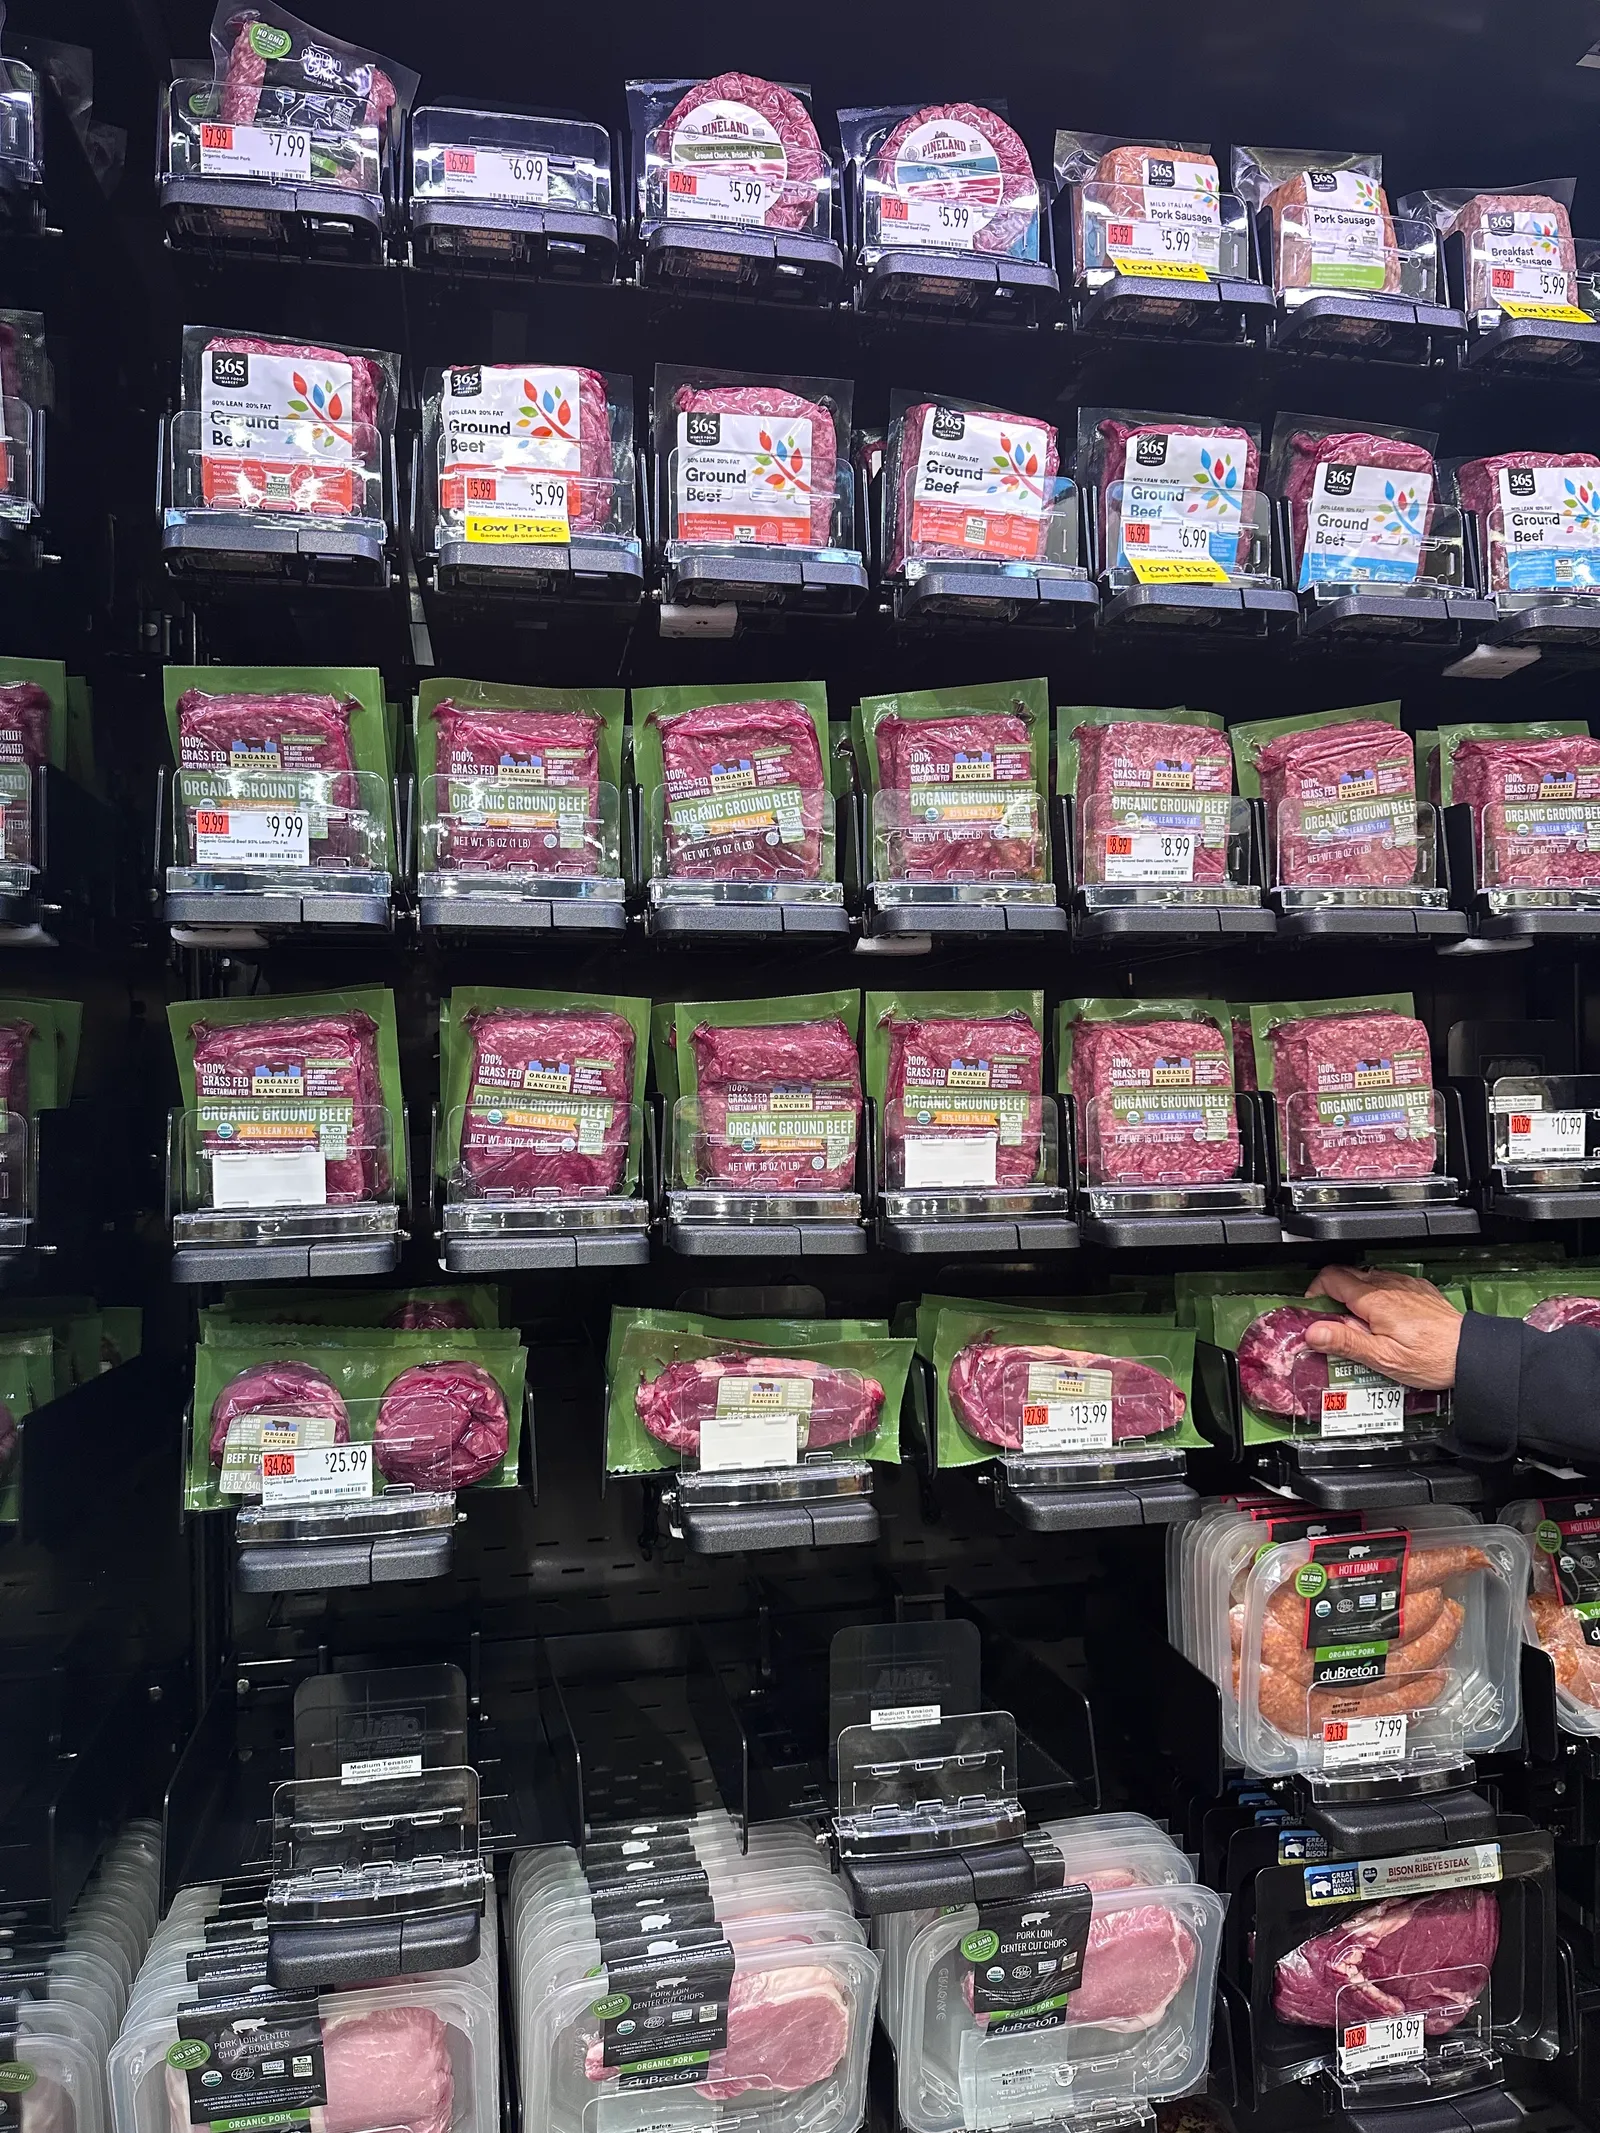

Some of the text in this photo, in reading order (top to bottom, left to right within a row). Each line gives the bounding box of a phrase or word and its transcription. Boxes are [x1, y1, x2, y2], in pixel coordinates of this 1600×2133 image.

[257, 28, 285, 46] NO GMO
[702, 121, 749, 135] PINELAND
[270, 134, 305, 158] $7.99
[922, 140, 966, 157] PINELAND
[695, 152, 713, 160] Ground
[509, 159, 543, 181] $6.99
[1151, 165, 1172, 178] 365
[729, 181, 762, 205] $5.99
[1150, 201, 1166, 209] MILD
[939, 206, 969, 229] $5.99
[1151, 209, 1213, 224] Pork Sausage
[1315, 214, 1375, 226] Pork Sausage
[1491, 217, 1512, 228] 365
[1162, 230, 1190, 252] $5.99
[1492, 247, 1534, 256] Breakfast
[1540, 275, 1565, 295] $5.99
[215, 359, 245, 376] 365
[453, 373, 478, 387] 365
[449, 419, 511, 435] Ground
[690, 420, 717, 434] 365
[935, 415, 962, 430] 365
[1139, 441, 1164, 455] 365
[686, 468, 746, 484] Ground
[926, 460, 984, 481] Ground
[924, 478, 960, 494] Beef
[1328, 471, 1352, 486] 365
[1510, 474, 1532, 488] 365
[531, 484, 564, 506] $5.99
[1131, 486, 1184, 502] Ground
[1130, 504, 1162, 517] Beef
[474, 523, 564, 532] Low Price
[1317, 514, 1369, 531] Ground
[1512, 514, 1560, 526] Ground
[1179, 529, 1207, 549] $6.99
[1514, 530, 1544, 542] Beef
[181, 751, 227, 762] GRASS FED
[234, 753, 277, 761] ORGANIC
[451, 764, 495, 775] GRASS FED
[508, 795, 588, 811] GROUND BEEF
[725, 790, 800, 817] GROUND BEEF
[1113, 796, 1229, 815] ORGANIC GROUND BEEF
[1304, 800, 1416, 830] ORGANIC GROUND BEEF
[1505, 807, 1585, 823] ORGANIC GROUND
[266, 816, 303, 837] $9.99
[1161, 838, 1190, 856] $8.99
[202, 1063, 225, 1074] 100%
[907, 1068, 946, 1078] GRASS FED
[202, 1076, 249, 1087] GRASS FED
[529, 1072, 567, 1081] ORGANIC
[527, 1081, 567, 1090] RANCHER
[1114, 1096, 1201, 1110] ORGANIC GROUND
[1320, 1091, 1430, 1114] ORGANIC GROUND BEEF
[247, 1126, 307, 1135] 93% LEAN 7% FAT
[728, 1120, 854, 1135] ORGANIC GROUND BEEF
[1552, 1117, 1582, 1135] $10.99
[1335, 1366, 1352, 1377] BEEF
[1367, 1390, 1400, 1409] $15.99
[1070, 1404, 1107, 1425] $13.99
[226, 1453, 246, 1464] BEEF
[325, 1451, 367, 1473] $25.99
[223, 1472, 251, 1481] NET WT.
[223, 1481, 243, 1489] 12 OZ
[1339, 1562, 1378, 1575] HOT ITALIAN
[1328, 1649, 1356, 1658] ORGANIC
[1320, 1665, 1378, 1680] duBreton
[1375, 1719, 1402, 1738] $7.99
[349, 1758, 414, 1770] Medium Tension
[1331, 1870, 1353, 1879] GREAT
[1388, 1858, 1470, 1877] BISON RIBEYE STEAK
[1332, 1877, 1354, 1885] RANGE
[1333, 1886, 1354, 1895] BISON
[1016, 1930, 1053, 1939] PORK LOIN
[968, 1936, 991, 1950] NO GMO
[1001, 1938, 1067, 1953] CENTER CUT CHOPS
[650, 1987, 690, 1998] PORK LOIN
[632, 1999, 660, 2010] CENTER
[678, 1992, 704, 2001] CHOPS
[995, 2016, 1058, 2034] duBreton
[1386, 2020, 1420, 2040] $18.99
[214, 2031, 290, 2049] PORK LOIN CENTER
[637, 2055, 694, 2070] ORGANIC PORK
[228, 2114, 292, 2129] ORGANIC PORK
